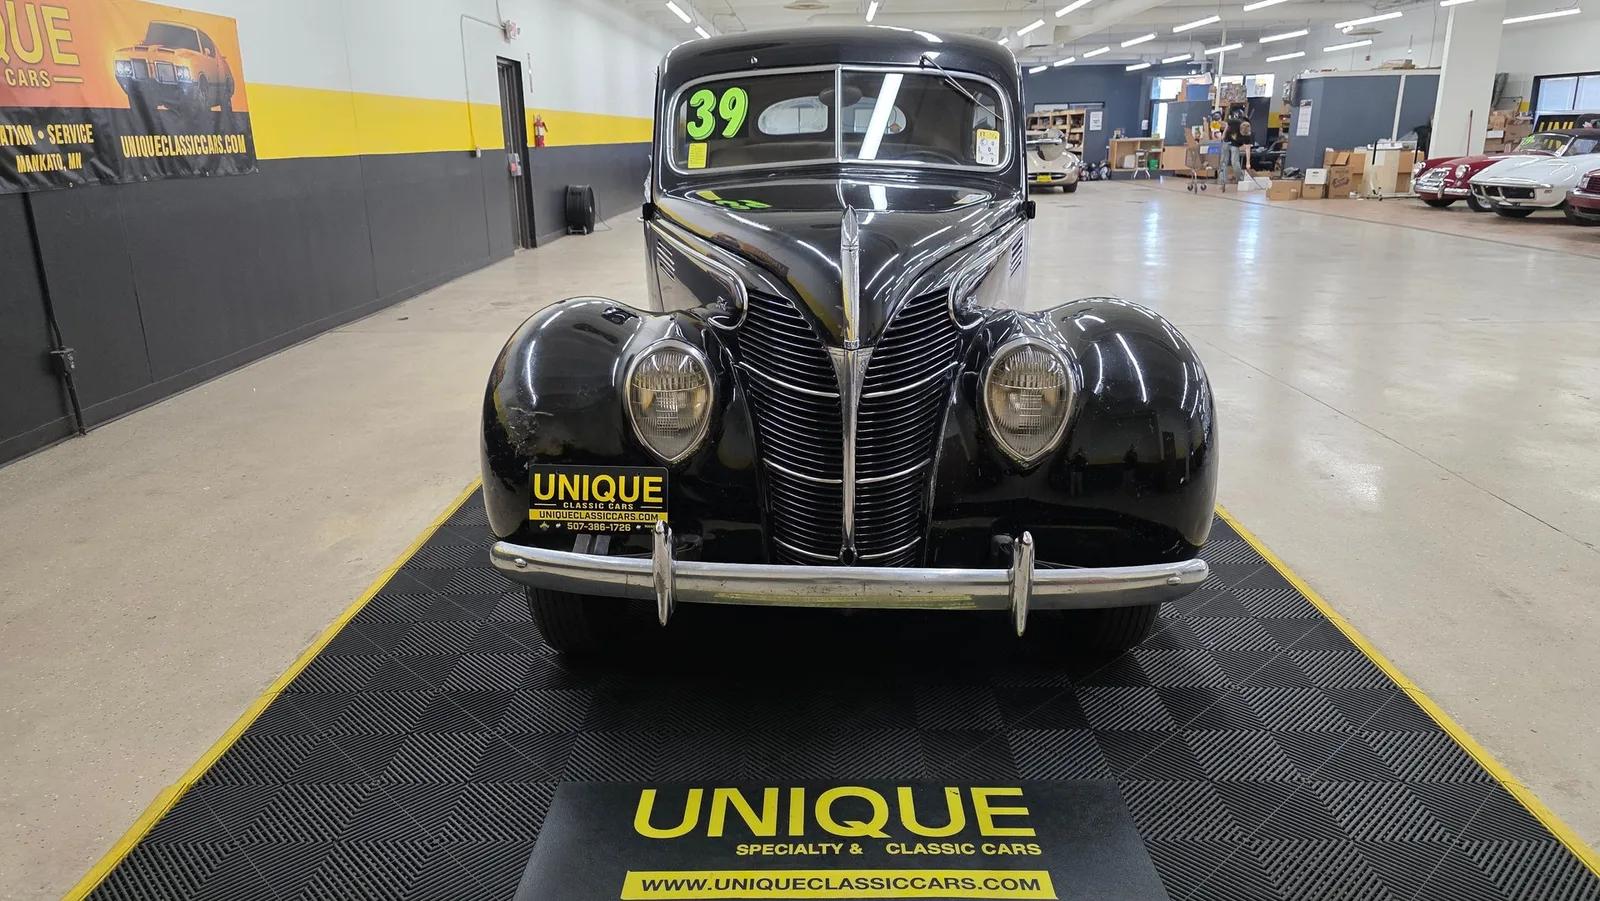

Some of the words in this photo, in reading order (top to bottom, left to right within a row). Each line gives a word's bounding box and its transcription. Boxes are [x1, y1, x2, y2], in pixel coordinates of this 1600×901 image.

[0, 0, 80, 66] UE
[4, 68, 51, 88] CARS
[686, 87, 749, 140] 39
[46, 123, 94, 145] SERVICE
[120, 134, 247, 158] UNIQUECLASSICCARS.COM
[15, 153, 67, 173] MANKATO,
[67, 152, 82, 170] MN
[533, 473, 663, 503] UNIQUE
[539, 510, 659, 521] UNIQUECLASSICCARS.COM
[563, 501, 605, 509] CLASSIC
[567, 522, 631, 532] 507-386-1726
[633, 786, 1037, 839] UNIQUE
[735, 843, 843, 856] SPECIALTY
[848, 843, 863, 855] &
[885, 843, 976, 855] CLASSIC
[981, 843, 1042, 856] CARS
[641, 877, 1041, 892] WWW.UNIQUECLASSICCARS.COM
